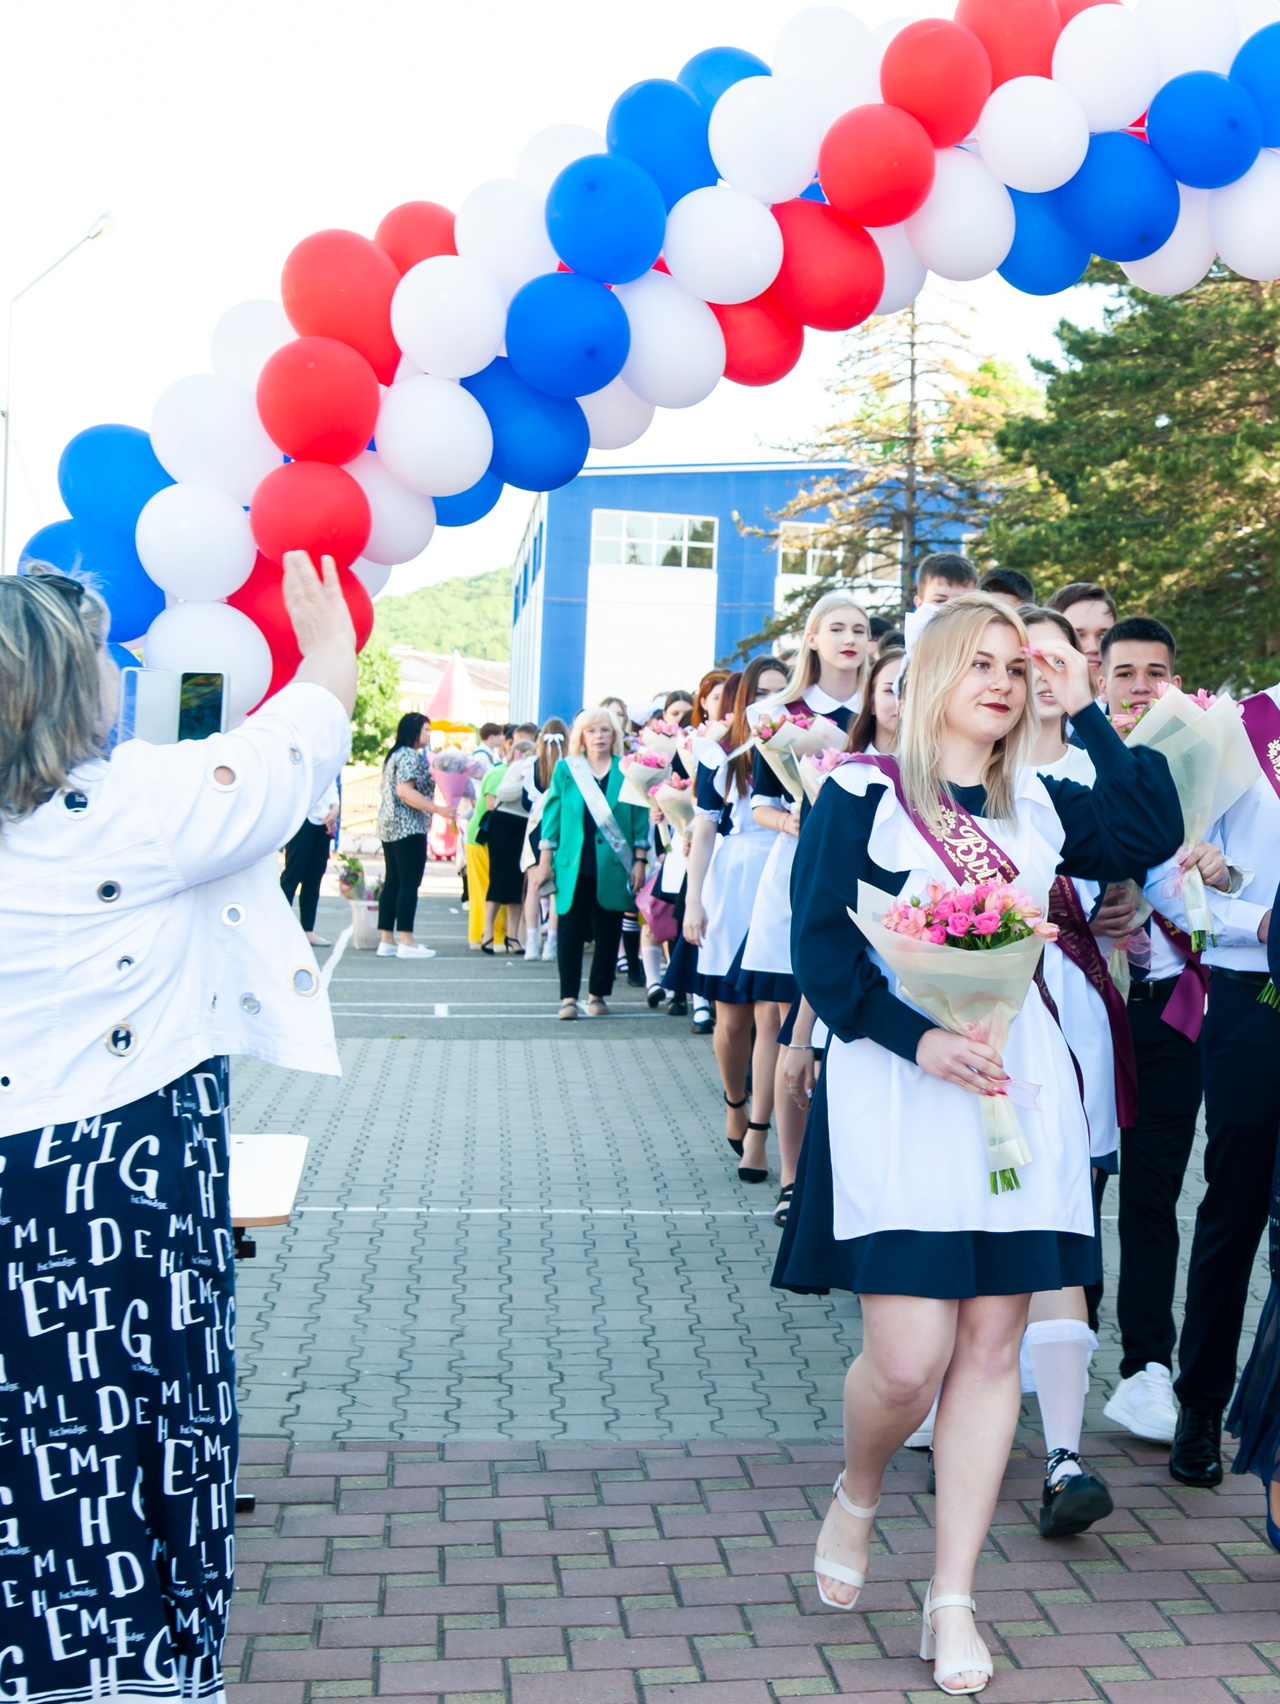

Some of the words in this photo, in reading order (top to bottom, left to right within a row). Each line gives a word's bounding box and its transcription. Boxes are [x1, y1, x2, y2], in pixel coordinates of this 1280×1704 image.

[88, 1218, 123, 1266] D
[96, 1386, 130, 1434] D
[106, 1551, 144, 1598] D
